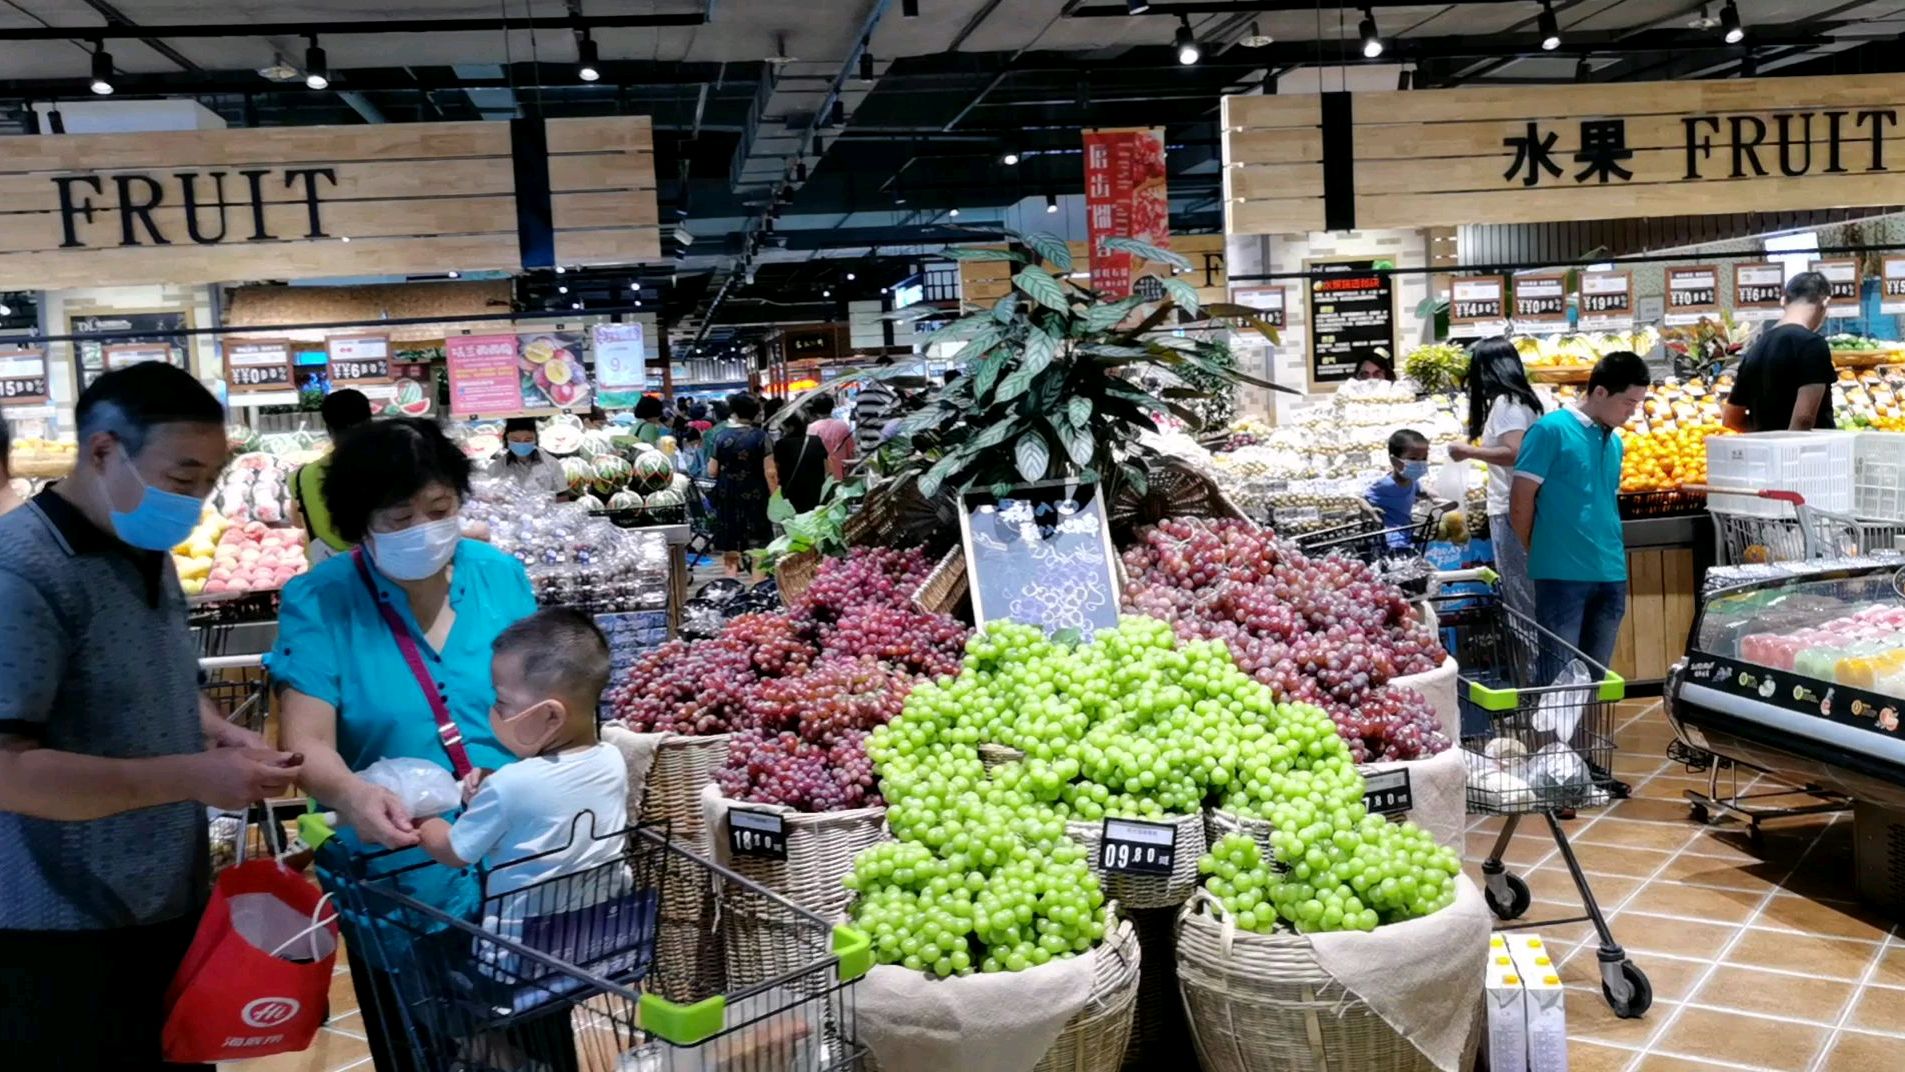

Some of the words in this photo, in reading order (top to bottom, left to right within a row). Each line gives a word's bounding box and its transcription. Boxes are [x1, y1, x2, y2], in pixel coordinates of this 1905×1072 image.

[1503, 118, 1633, 187] 水果
[1682, 110, 1898, 180] FRUIT
[51, 168, 338, 248] FRUIT
